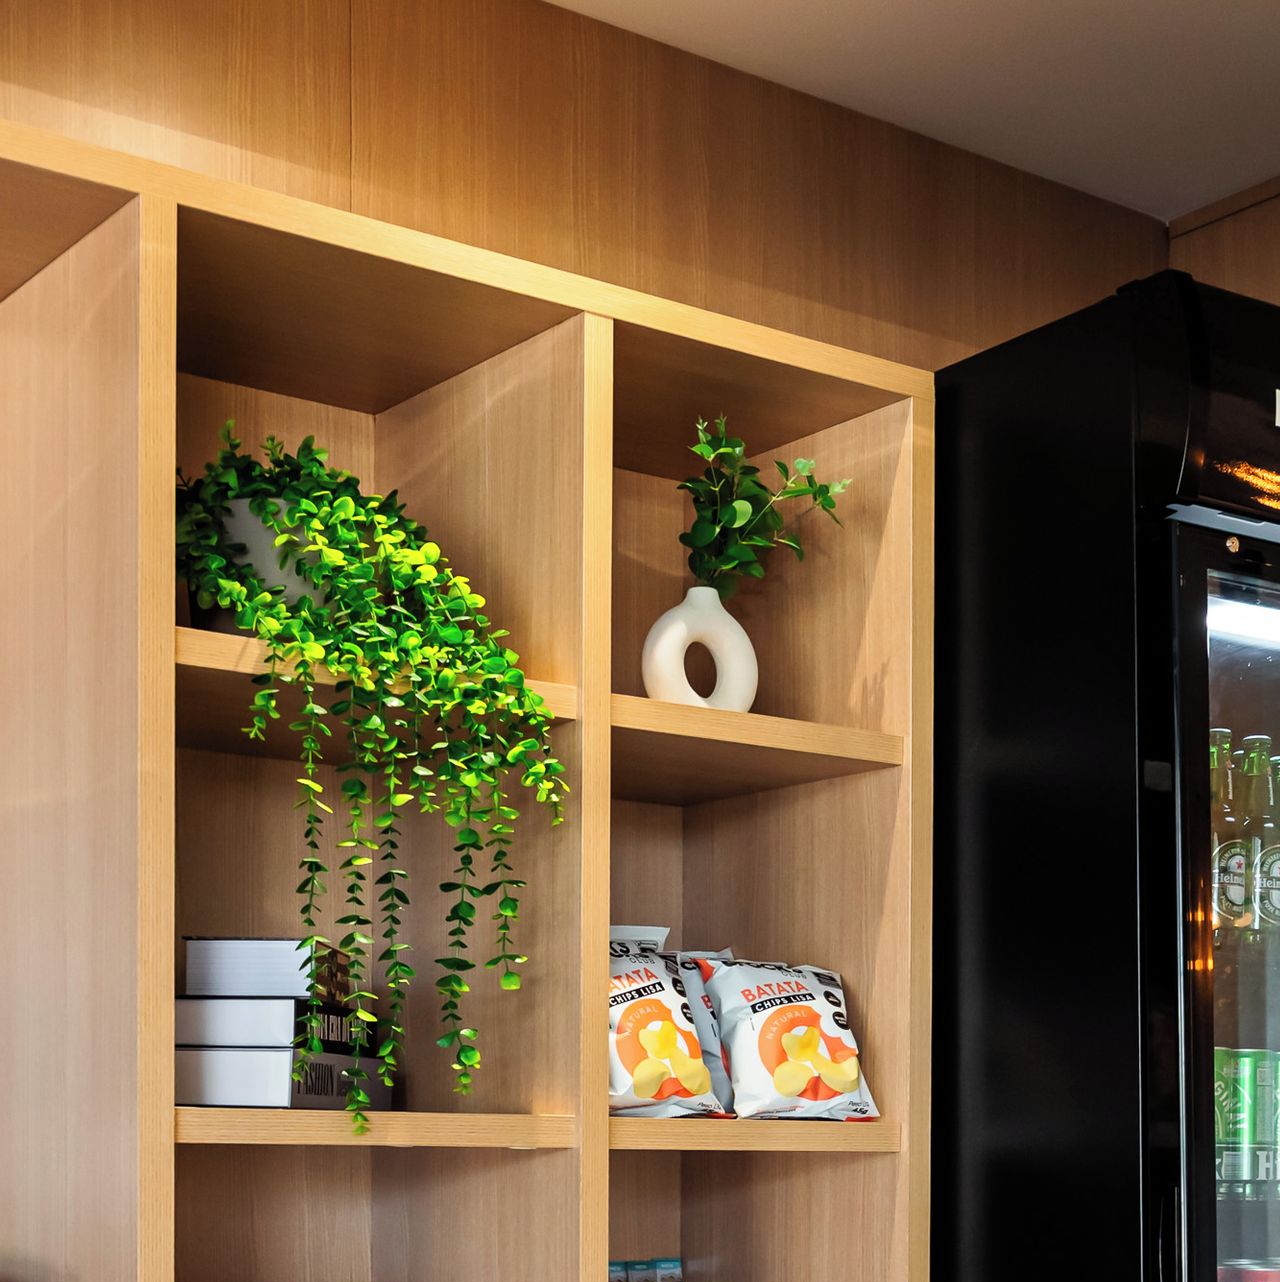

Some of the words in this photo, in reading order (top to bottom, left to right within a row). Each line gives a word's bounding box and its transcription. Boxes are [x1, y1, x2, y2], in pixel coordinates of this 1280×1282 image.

[609, 992, 639, 1006] CHIPS
[640, 983, 663, 995] LISA
[740, 980, 809, 1004] BATATA
[754, 997, 788, 1012] CHIPS
[791, 994, 812, 1003] LISA
[764, 1009, 807, 1040] NATURAL
